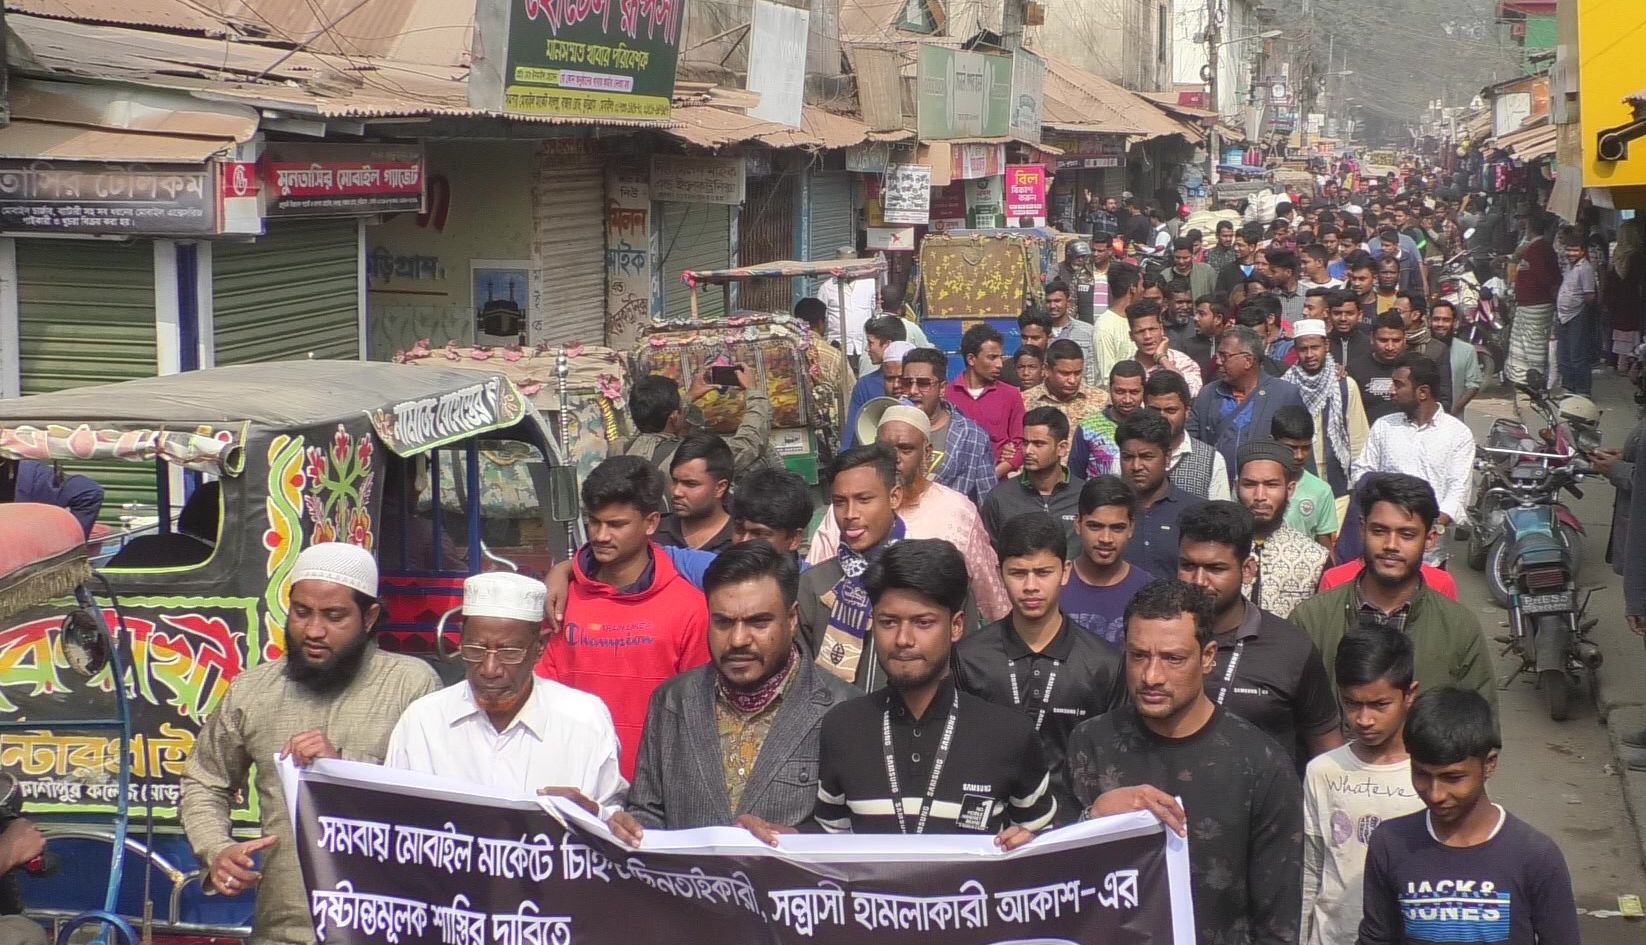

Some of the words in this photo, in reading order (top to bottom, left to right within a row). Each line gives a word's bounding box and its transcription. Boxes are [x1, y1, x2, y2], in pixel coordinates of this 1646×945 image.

[546, 39, 586, 63] মানসম্মত
[586, 44, 611, 67] খাবার
[612, 42, 650, 71] পরিবেশক
[277, 163, 333, 196] মুনতাসির
[337, 165, 380, 190] মোবাইল
[384, 164, 419, 188] গ্যাজেট
[1014, 170, 1039, 185] বিল
[608, 199, 648, 237] মিলন
[565, 622, 653, 657] Champion
[0, 722, 197, 777] ন্টারপ্রাই
[940, 714, 957, 751] SAMSUNG
[886, 754, 899, 794] SAMSUNG
[926, 758, 944, 798] SAMSUNG
[963, 783, 992, 793] SAMSUNG
[1327, 775, 1420, 798] Whateve
[317, 816, 391, 863] সমবায়
[394, 821, 474, 874] মোবাইল
[477, 833, 554, 882] মার্কেটে
[768, 880, 845, 937] সন্ত্রাসী
[851, 880, 988, 932] হামলাকারী
[994, 869, 1139, 923] আকাশ-এর
[1407, 880, 1477, 897] JACK
[1479, 881, 1497, 895] &
[312, 880, 428, 944] দৃষ্টান্তমূলক
[430, 894, 487, 945] শাস্তির
[492, 900, 572, 945] দাবিতে
[1402, 902, 1501, 921] JONES
